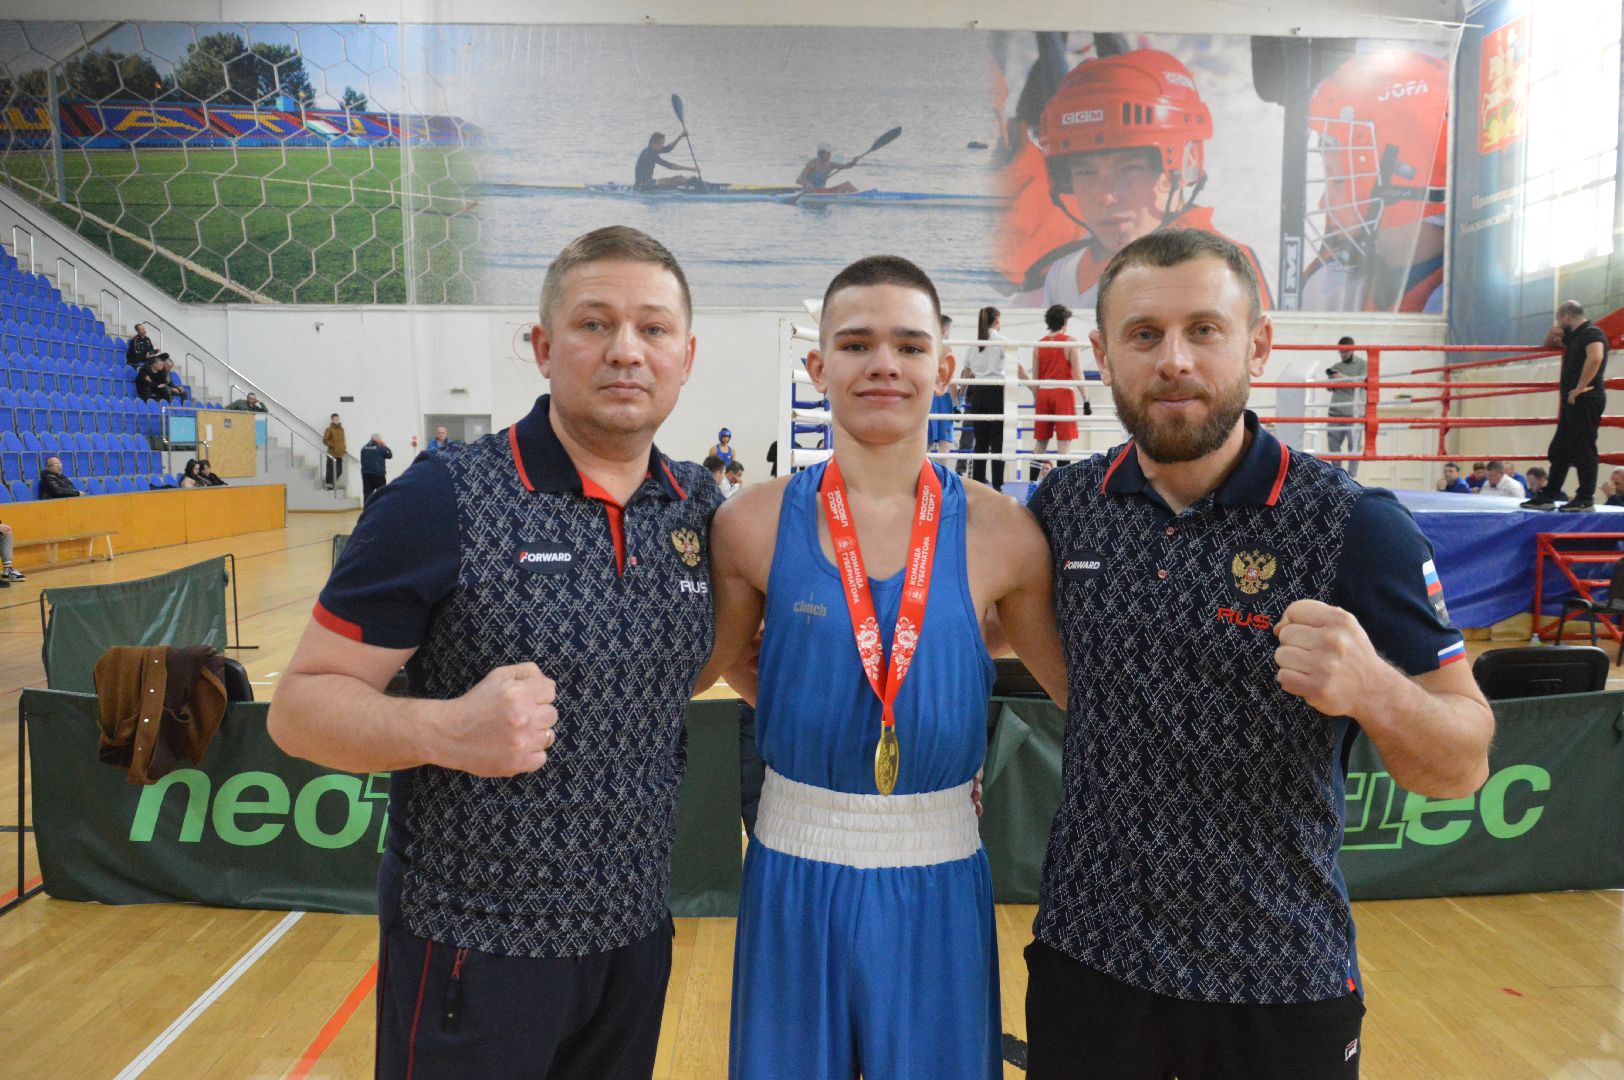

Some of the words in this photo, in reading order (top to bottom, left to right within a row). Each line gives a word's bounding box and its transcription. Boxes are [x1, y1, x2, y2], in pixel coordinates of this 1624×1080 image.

[1378, 80, 1428, 101] JOFA
[1063, 110, 1103, 124] CCM
[827, 492, 840, 520] СПОРТ
[834, 490, 849, 527] МОСОБЛ
[926, 493, 936, 522] СПОРТ
[519, 551, 572, 563] FORWARD
[849, 550, 864, 589] КОМАНДА
[910, 547, 921, 586] КОМАНДА
[917, 536, 930, 587] ГУБЕРНАТОРА
[1063, 559, 1101, 571] FORWARD
[680, 579, 709, 594] RUS
[841, 552, 860, 604] ГУБЕРНАТОРА
[1217, 607, 1271, 630] RUS
